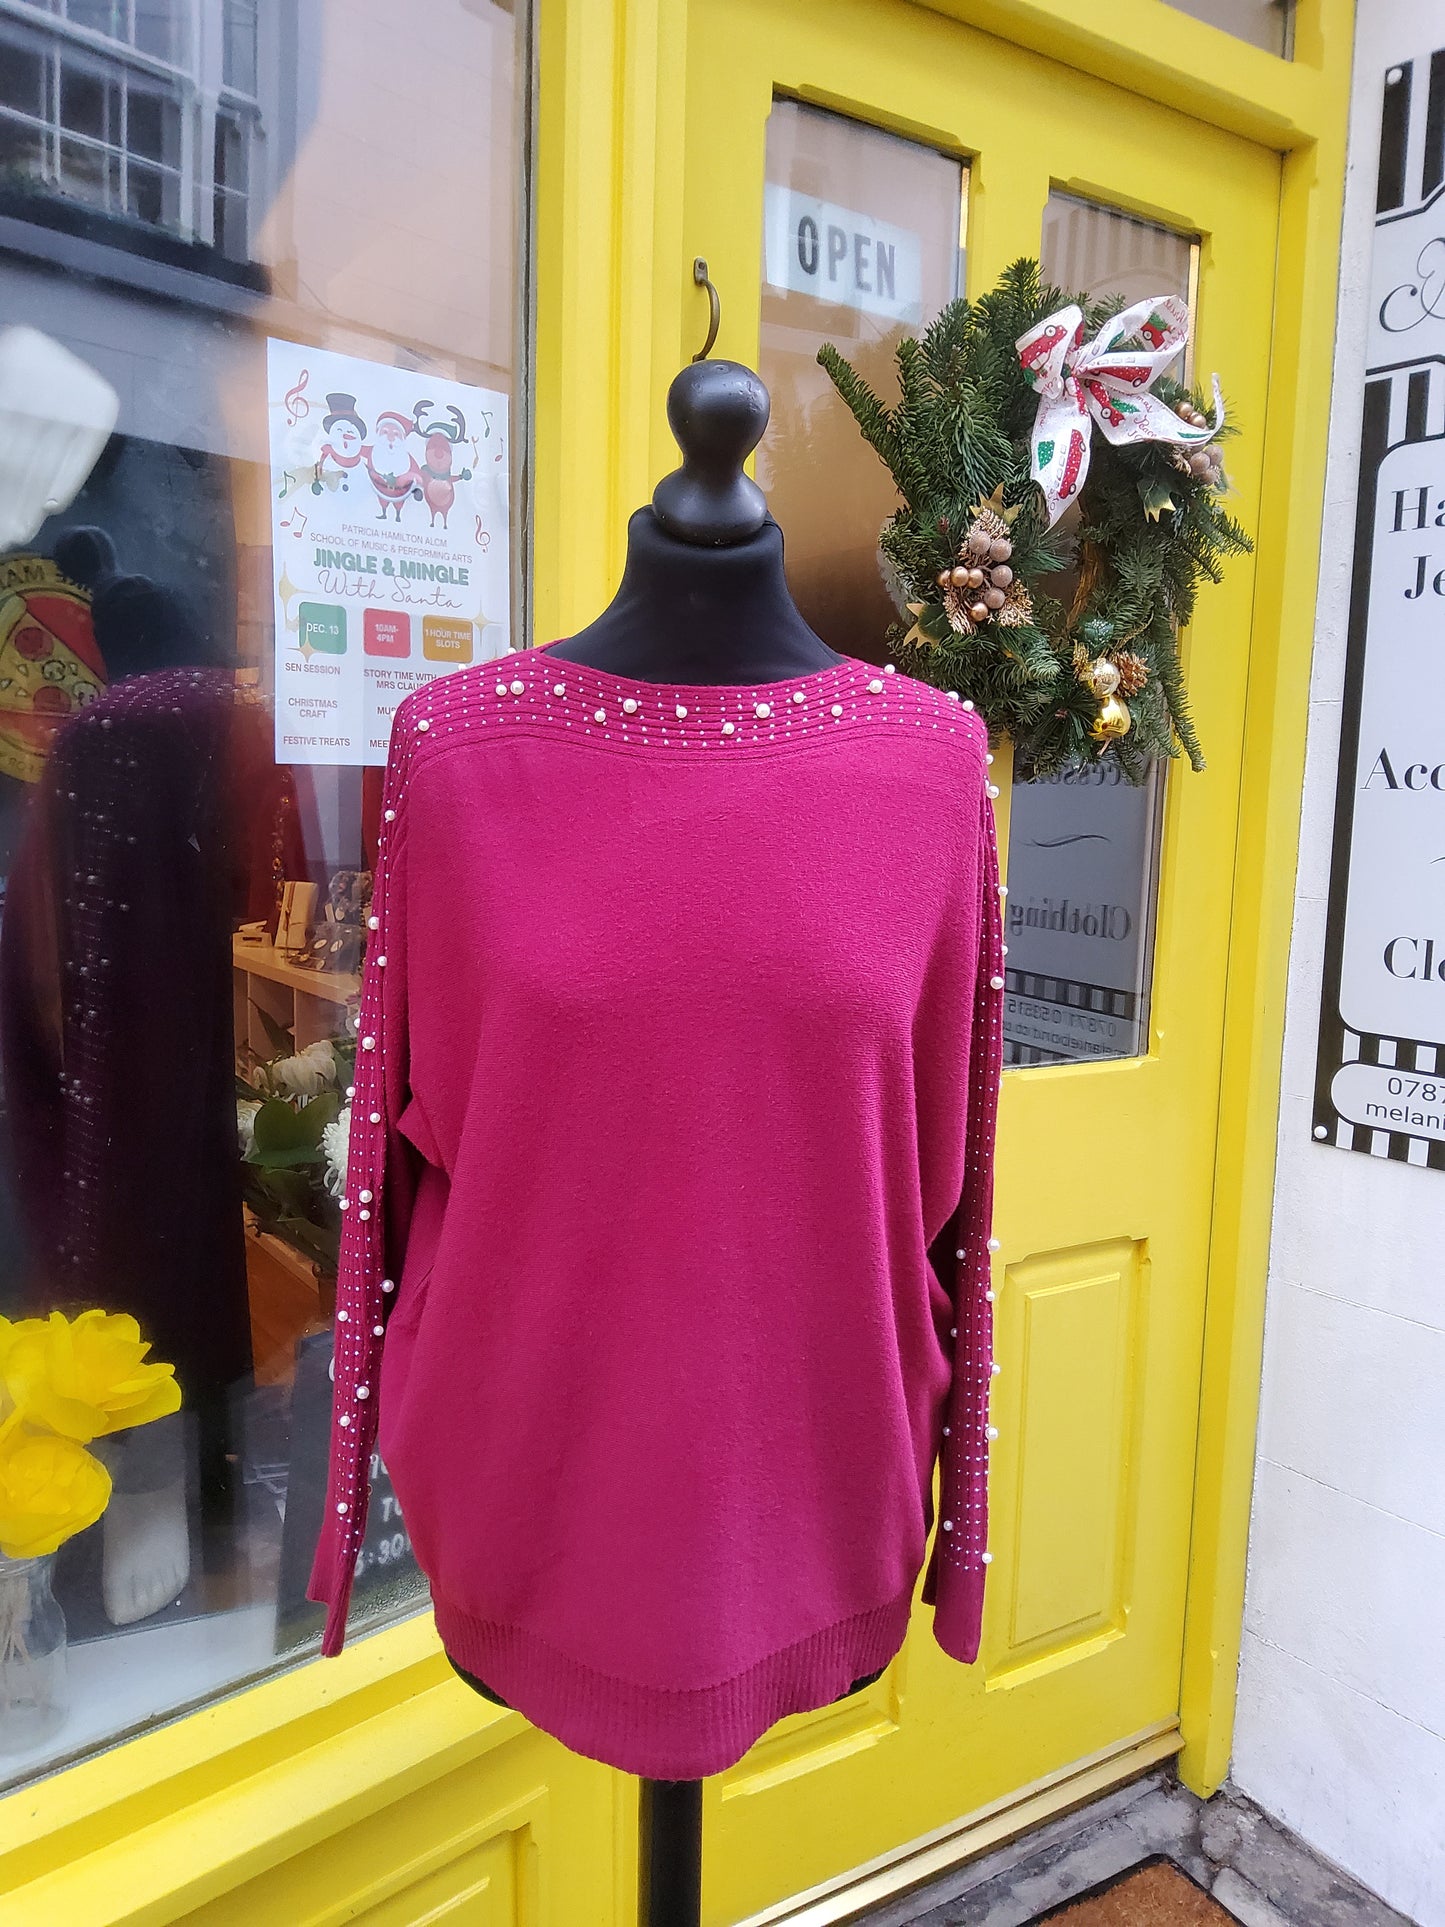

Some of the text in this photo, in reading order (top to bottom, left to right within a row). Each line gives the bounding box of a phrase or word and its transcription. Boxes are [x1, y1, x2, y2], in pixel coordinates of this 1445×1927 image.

[797, 215, 896, 300] OPEN
[342, 524, 379, 537] PATRICIA
[381, 531, 423, 544] HAMILTON
[310, 532, 473, 564] SCHOOL OF MUSIC & PERFORMING ARTS
[313, 547, 469, 586] JINGLE & MINGLE
[317, 569, 463, 609] With Santa
[306, 622, 339, 635] DEC. 13
[375, 623, 399, 633] 10AM-
[376, 633, 394, 643] 4PM
[430, 630, 452, 639] HOUR
[453, 631, 472, 641] TIME
[435, 640, 461, 649] SLOTS
[285, 662, 341, 675] SEN SESSION
[363, 668, 437, 681] STORY TIME WITH
[376, 680, 396, 690] MRS
[288, 697, 338, 709] CHRISTMAS
[299, 709, 327, 718] CRAFT
[283, 735, 351, 747] FESTIVE TREATS
[1383, 936, 1445, 982] Cl
